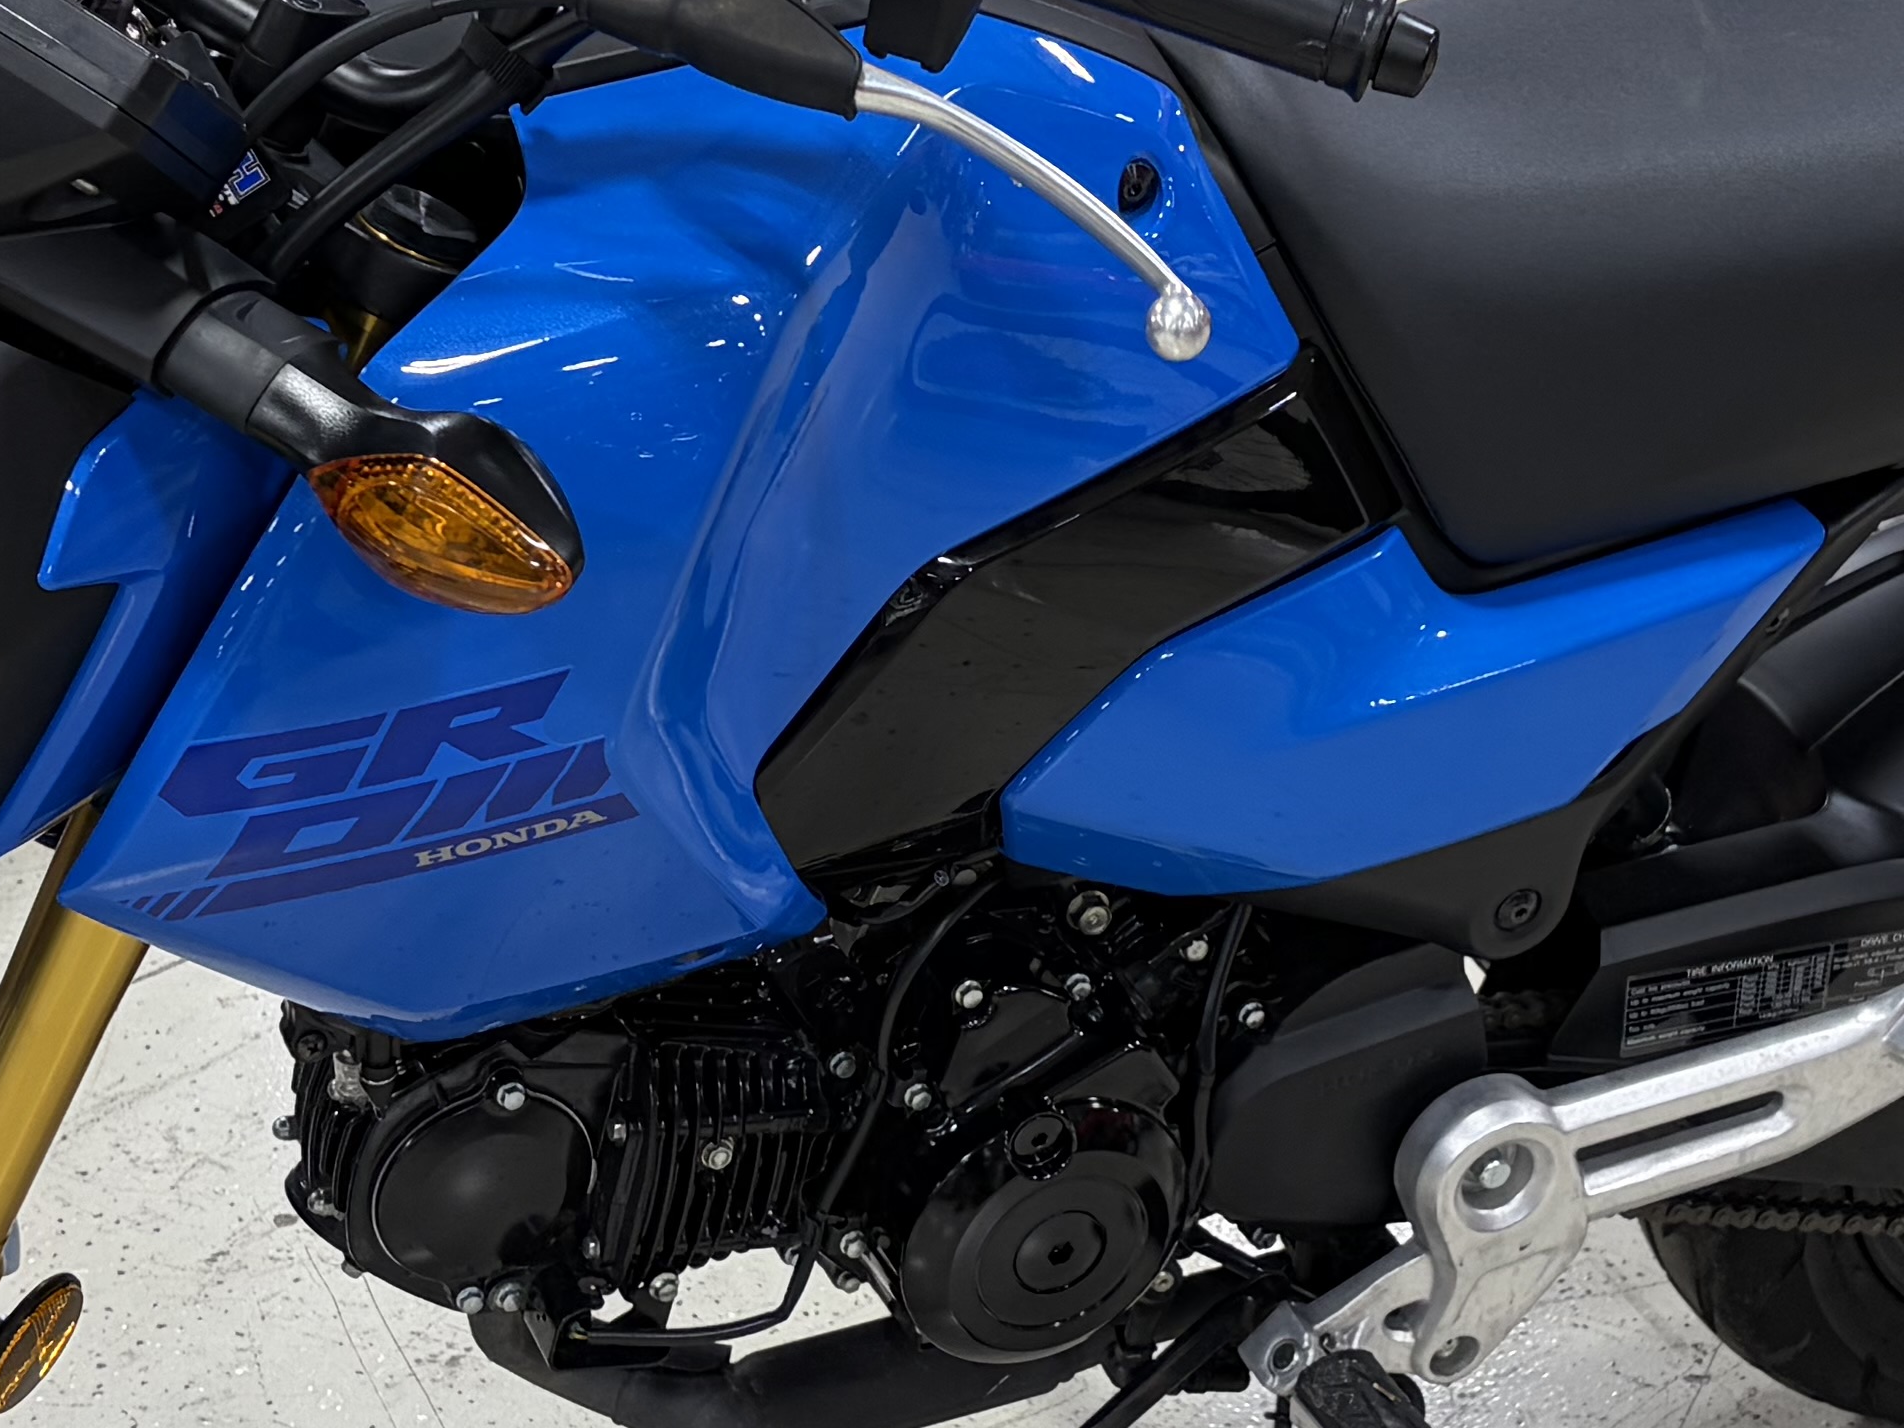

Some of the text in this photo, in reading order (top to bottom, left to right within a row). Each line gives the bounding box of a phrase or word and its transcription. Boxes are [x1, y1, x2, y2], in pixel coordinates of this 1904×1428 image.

[415, 809, 608, 868] HONDA
[1687, 955, 1775, 979] TIRE INFORMATION
